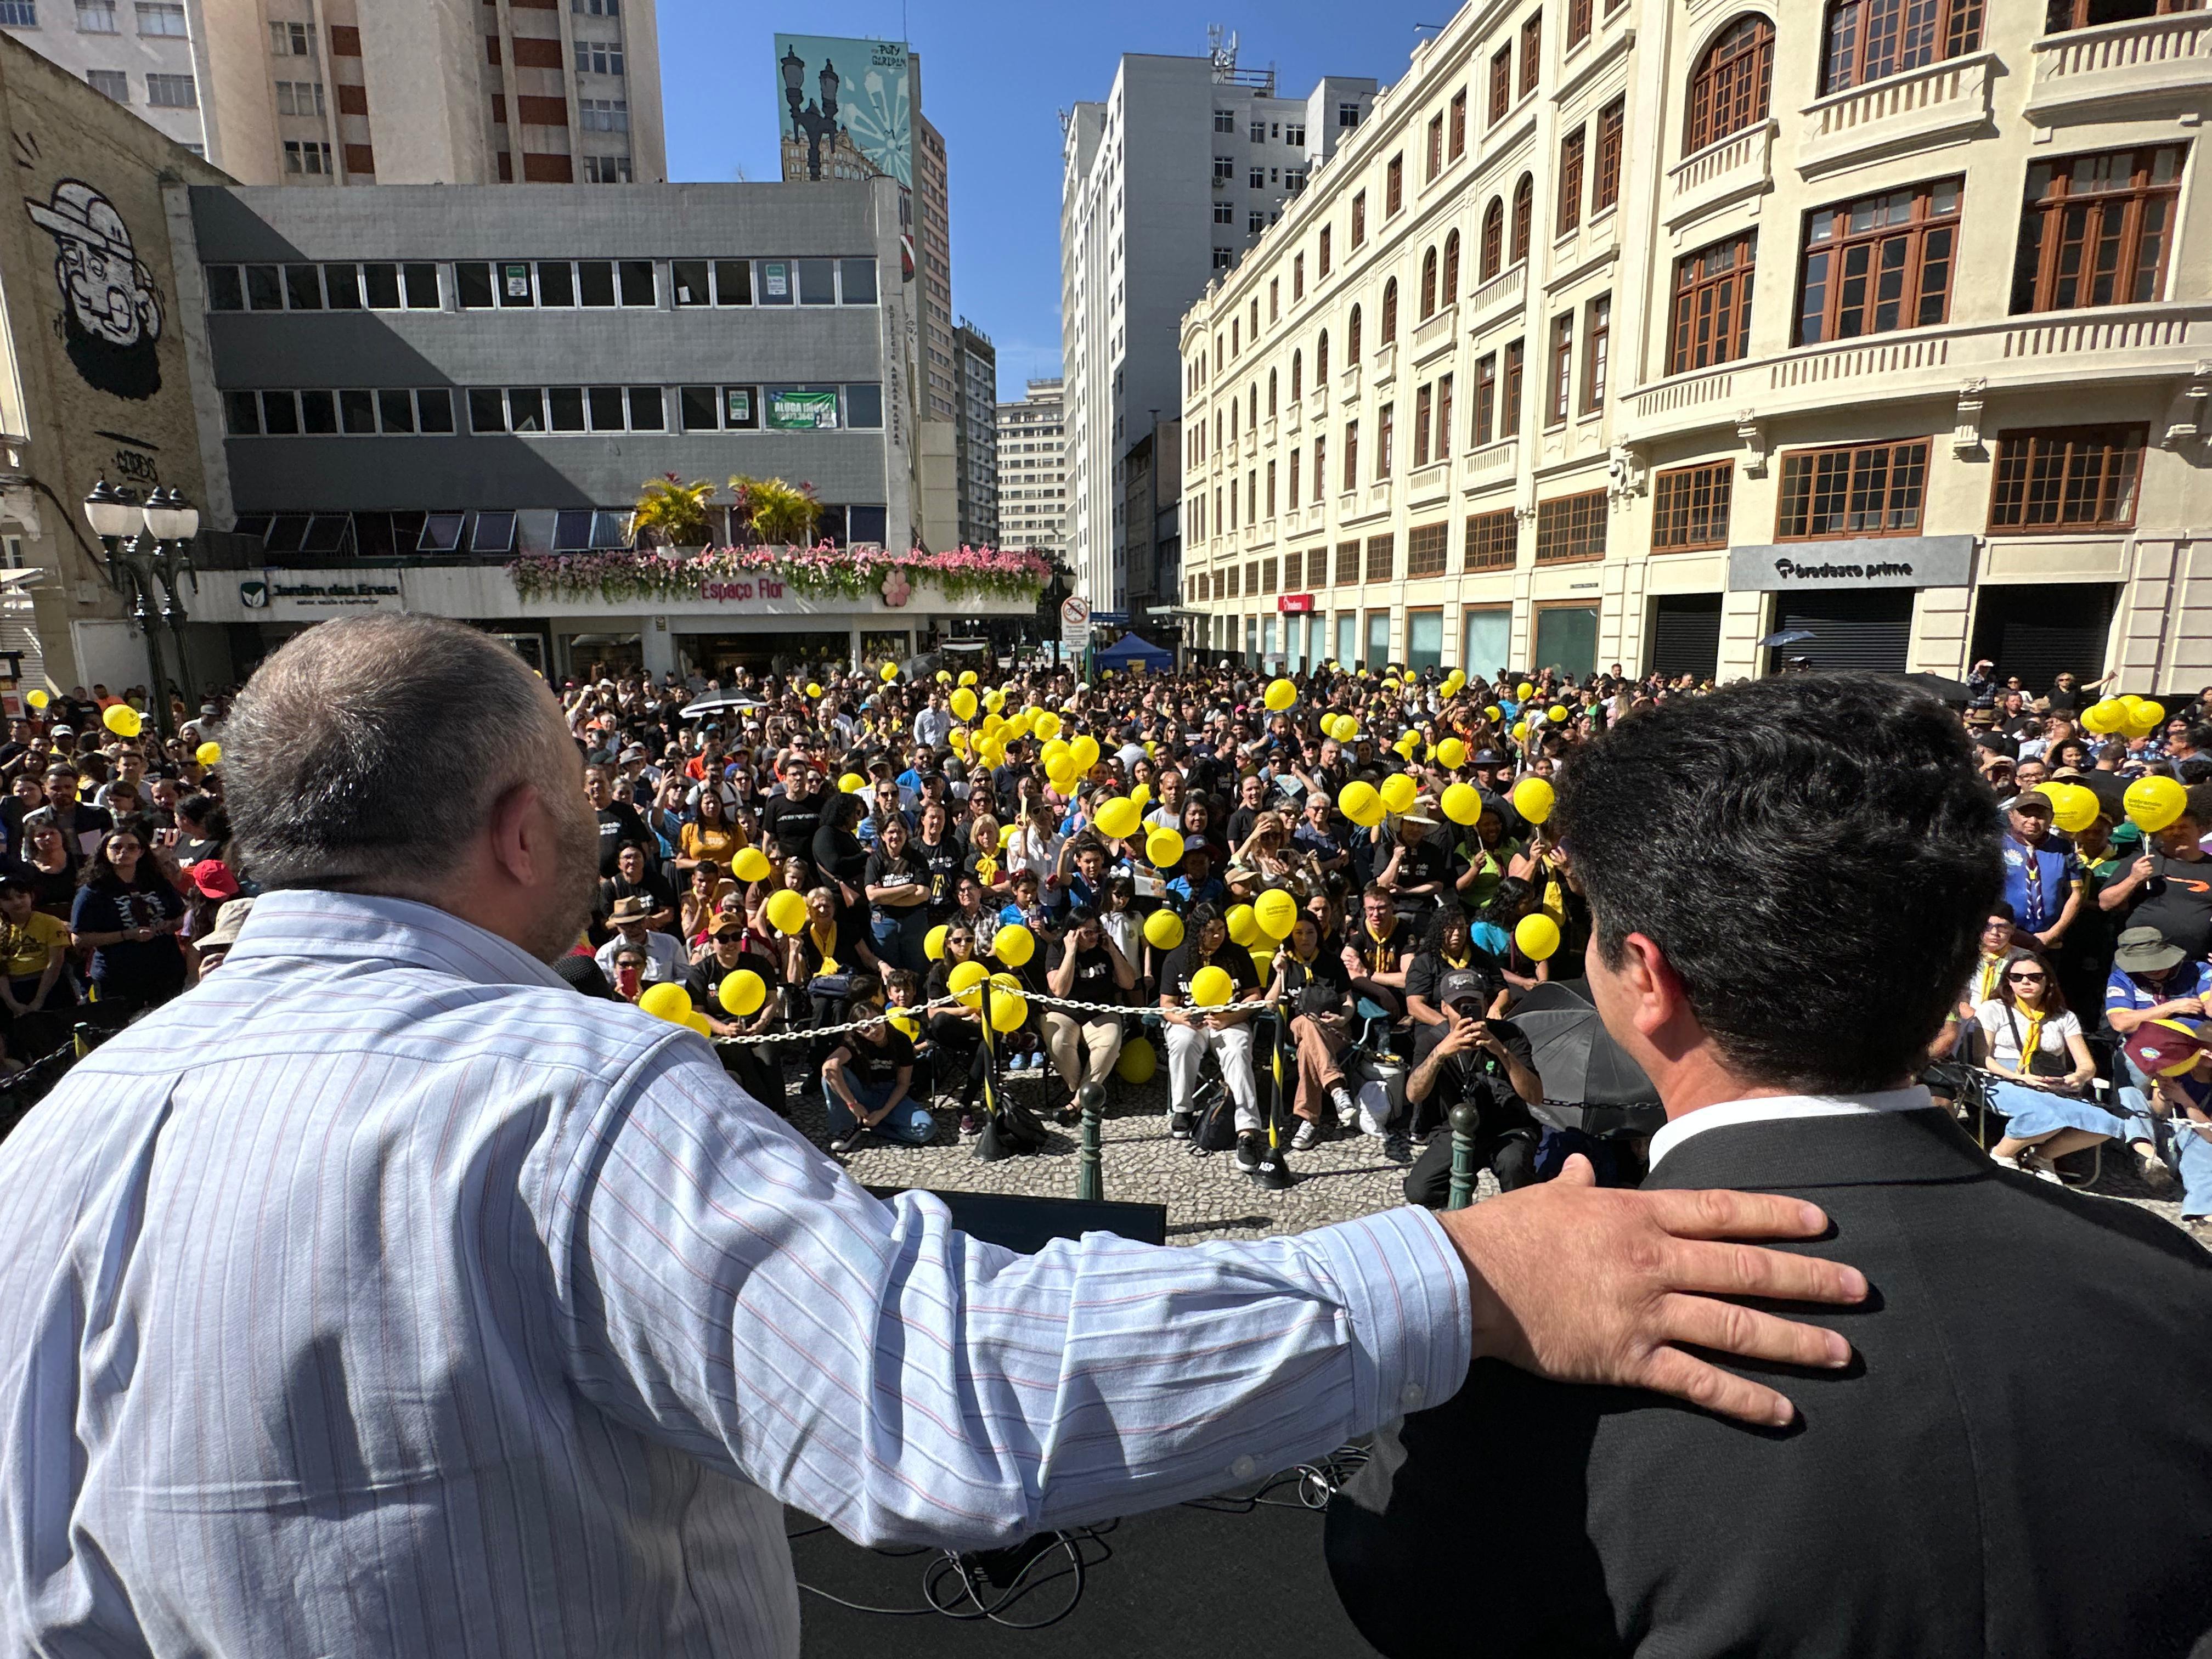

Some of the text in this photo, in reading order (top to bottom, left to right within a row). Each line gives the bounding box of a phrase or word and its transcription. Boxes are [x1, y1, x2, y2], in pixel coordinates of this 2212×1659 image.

[775, 402, 802, 413] ALUGA
[1796, 561, 1913, 580] bradesco prime
[274, 584, 398, 595] Jardim das Ervas
[701, 578, 786, 603] Espaço Flor
[1259, 1161, 1275, 1172] ASP
